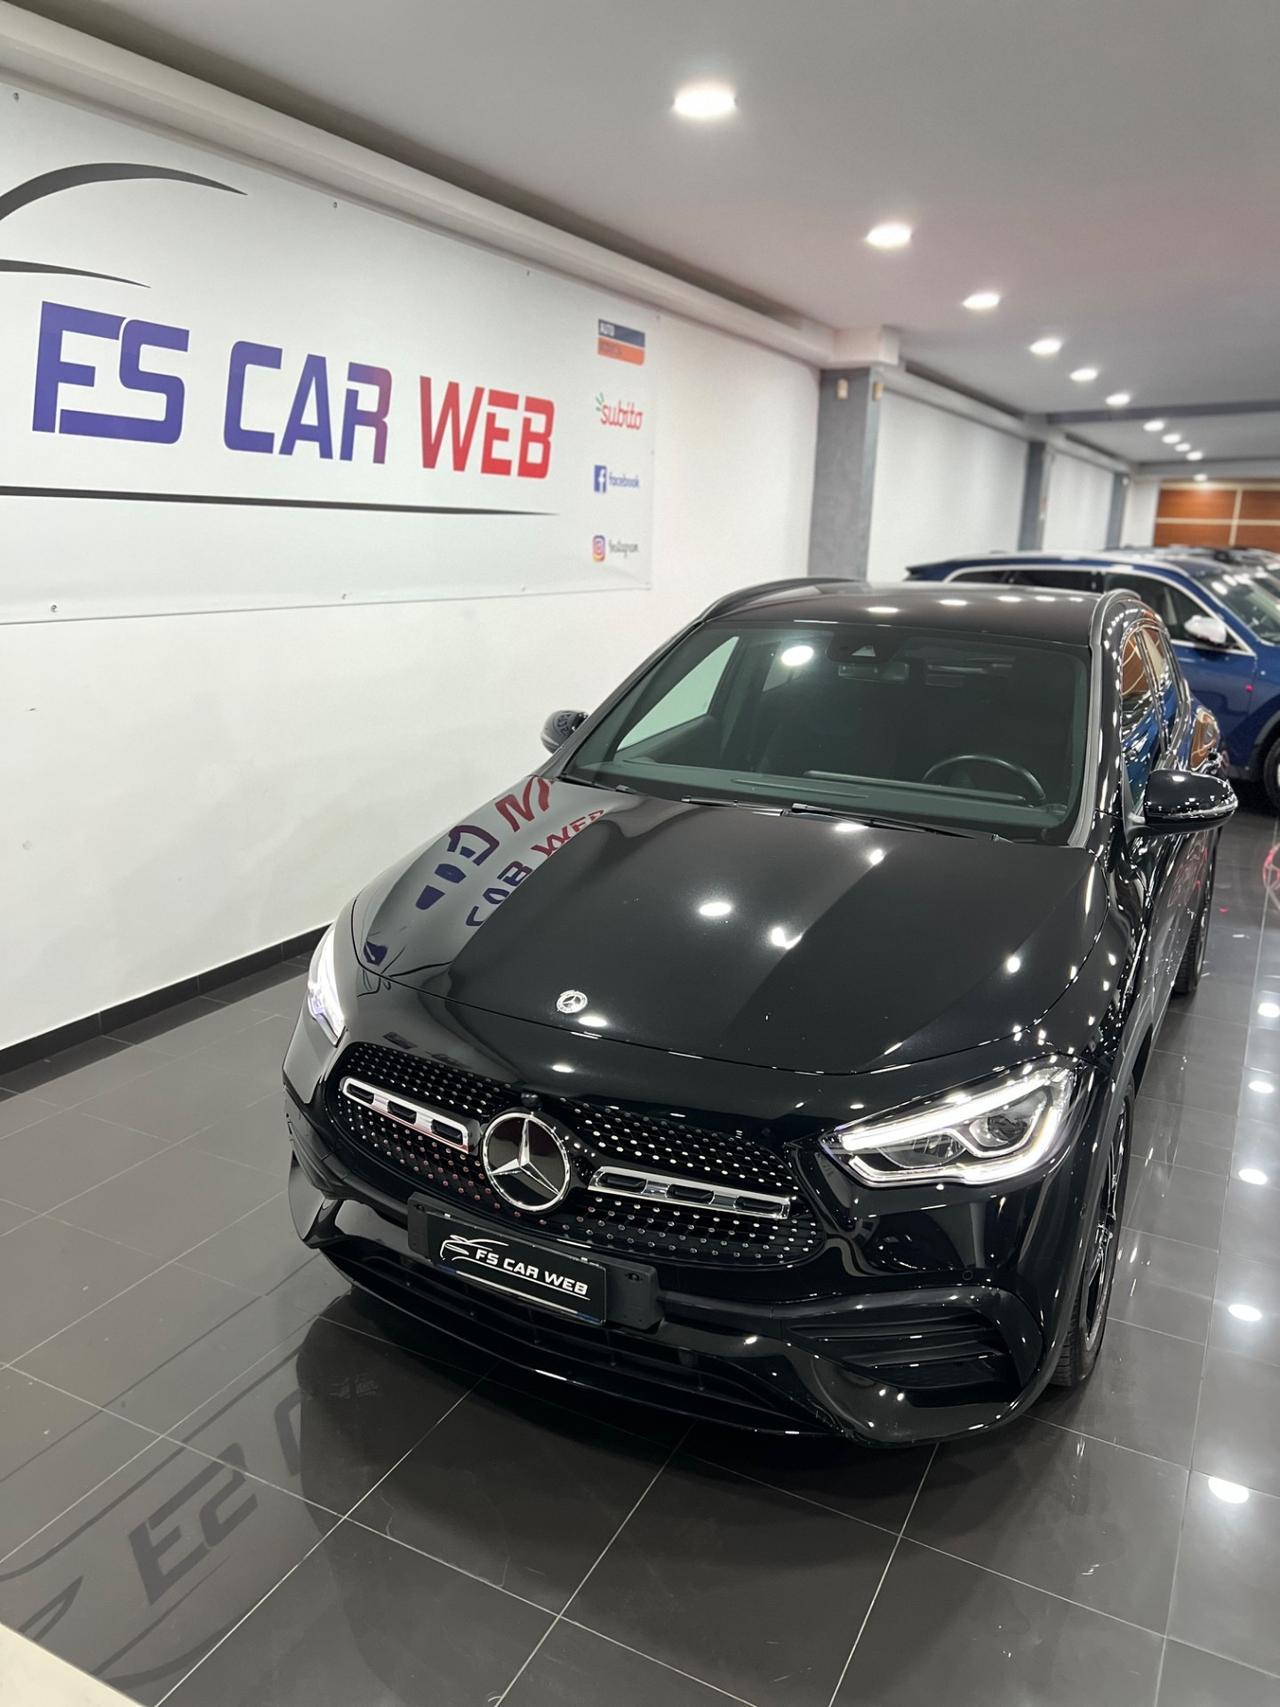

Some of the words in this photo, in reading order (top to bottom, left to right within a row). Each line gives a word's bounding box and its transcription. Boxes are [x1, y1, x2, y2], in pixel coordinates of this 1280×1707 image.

[32, 300, 190, 445] FS
[223, 340, 393, 465] CAR
[418, 374, 555, 480] WEB
[600, 400, 643, 430] subito
[476, 1249, 499, 1265] FS
[503, 1258, 540, 1278] CAR
[544, 1271, 588, 1295] WEB
